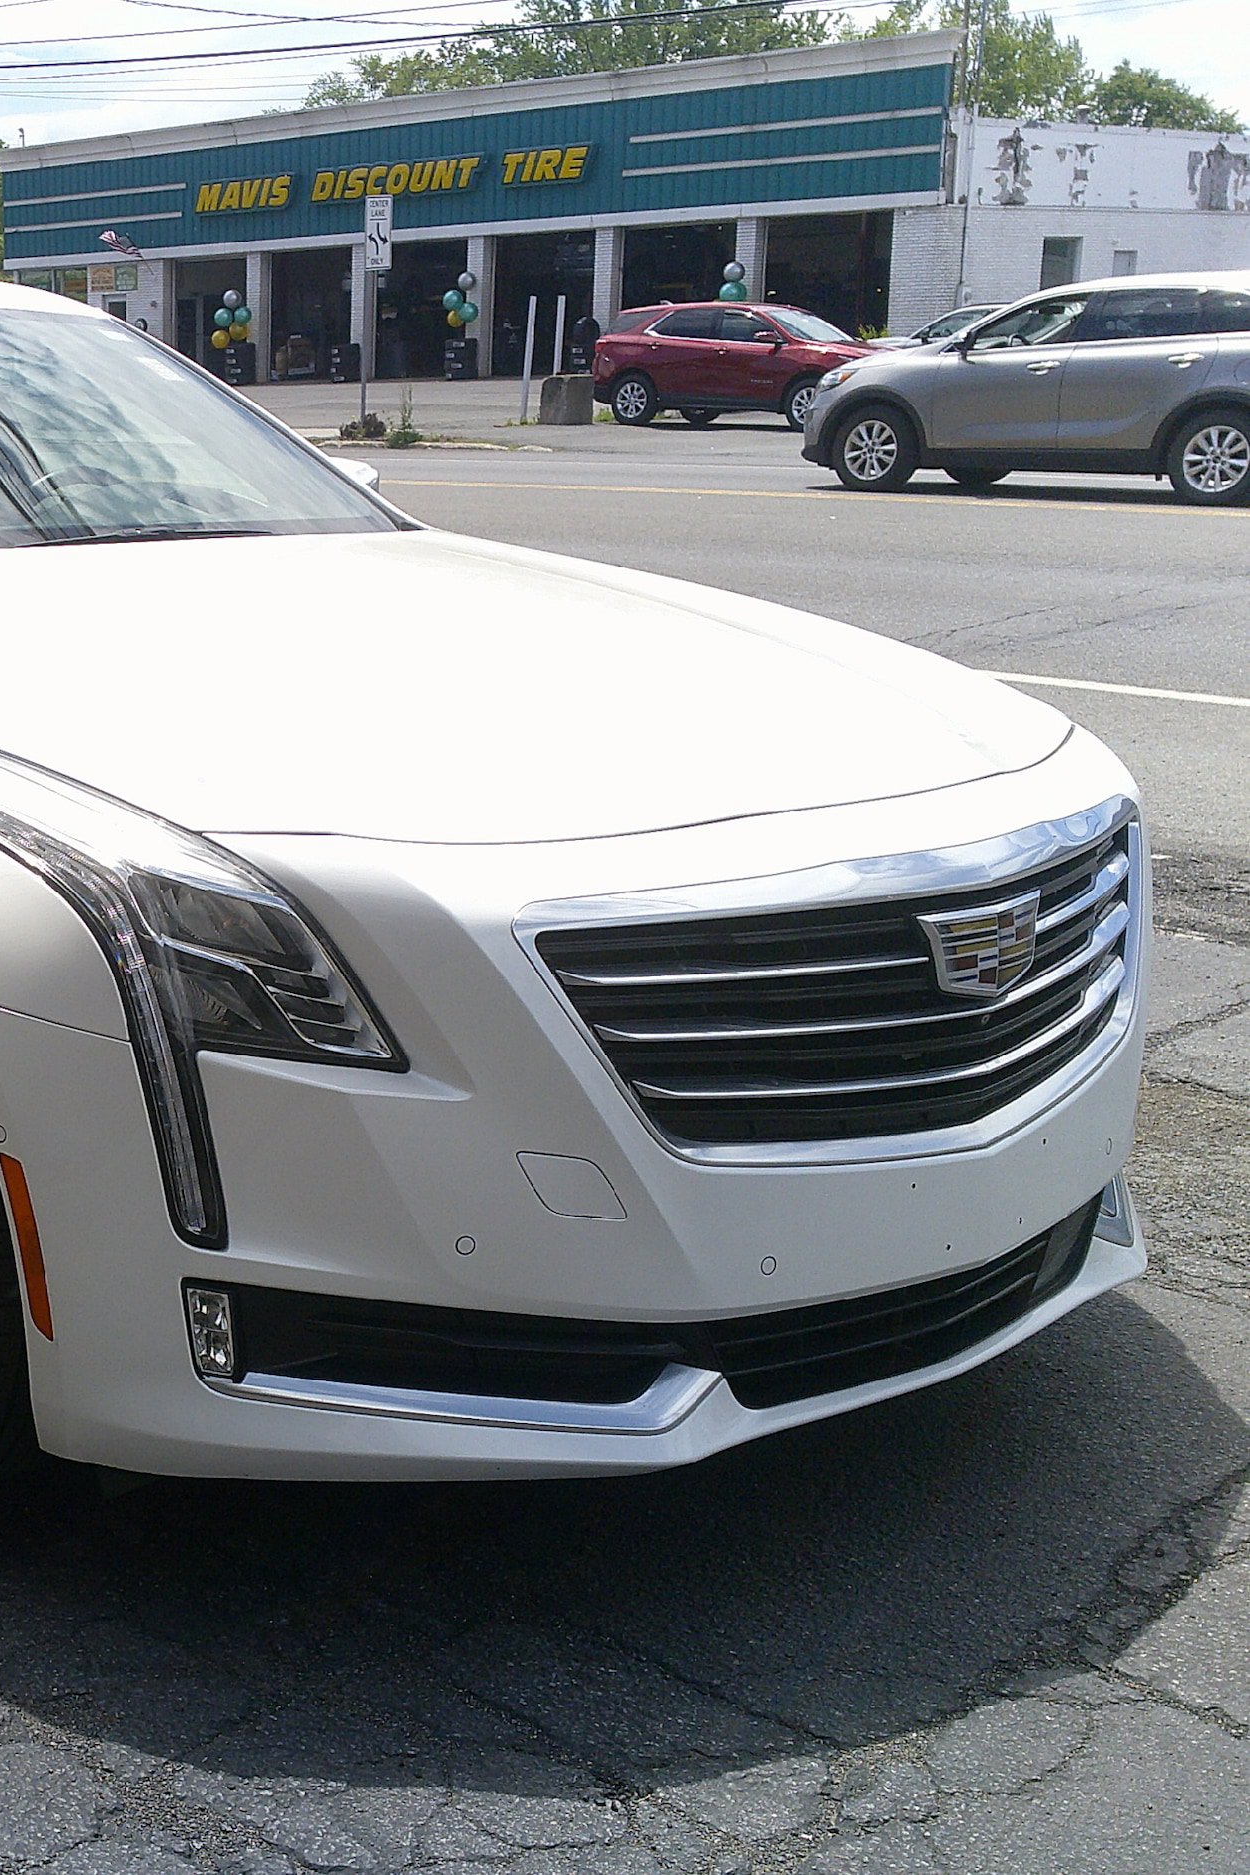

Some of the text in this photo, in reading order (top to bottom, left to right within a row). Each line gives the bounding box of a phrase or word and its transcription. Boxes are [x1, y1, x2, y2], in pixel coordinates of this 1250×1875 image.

[195, 146, 588, 213] MAVIS DISCOUNT TIRE
[369, 199, 389, 208] CENTER
[371, 209, 386, 217] LANE
